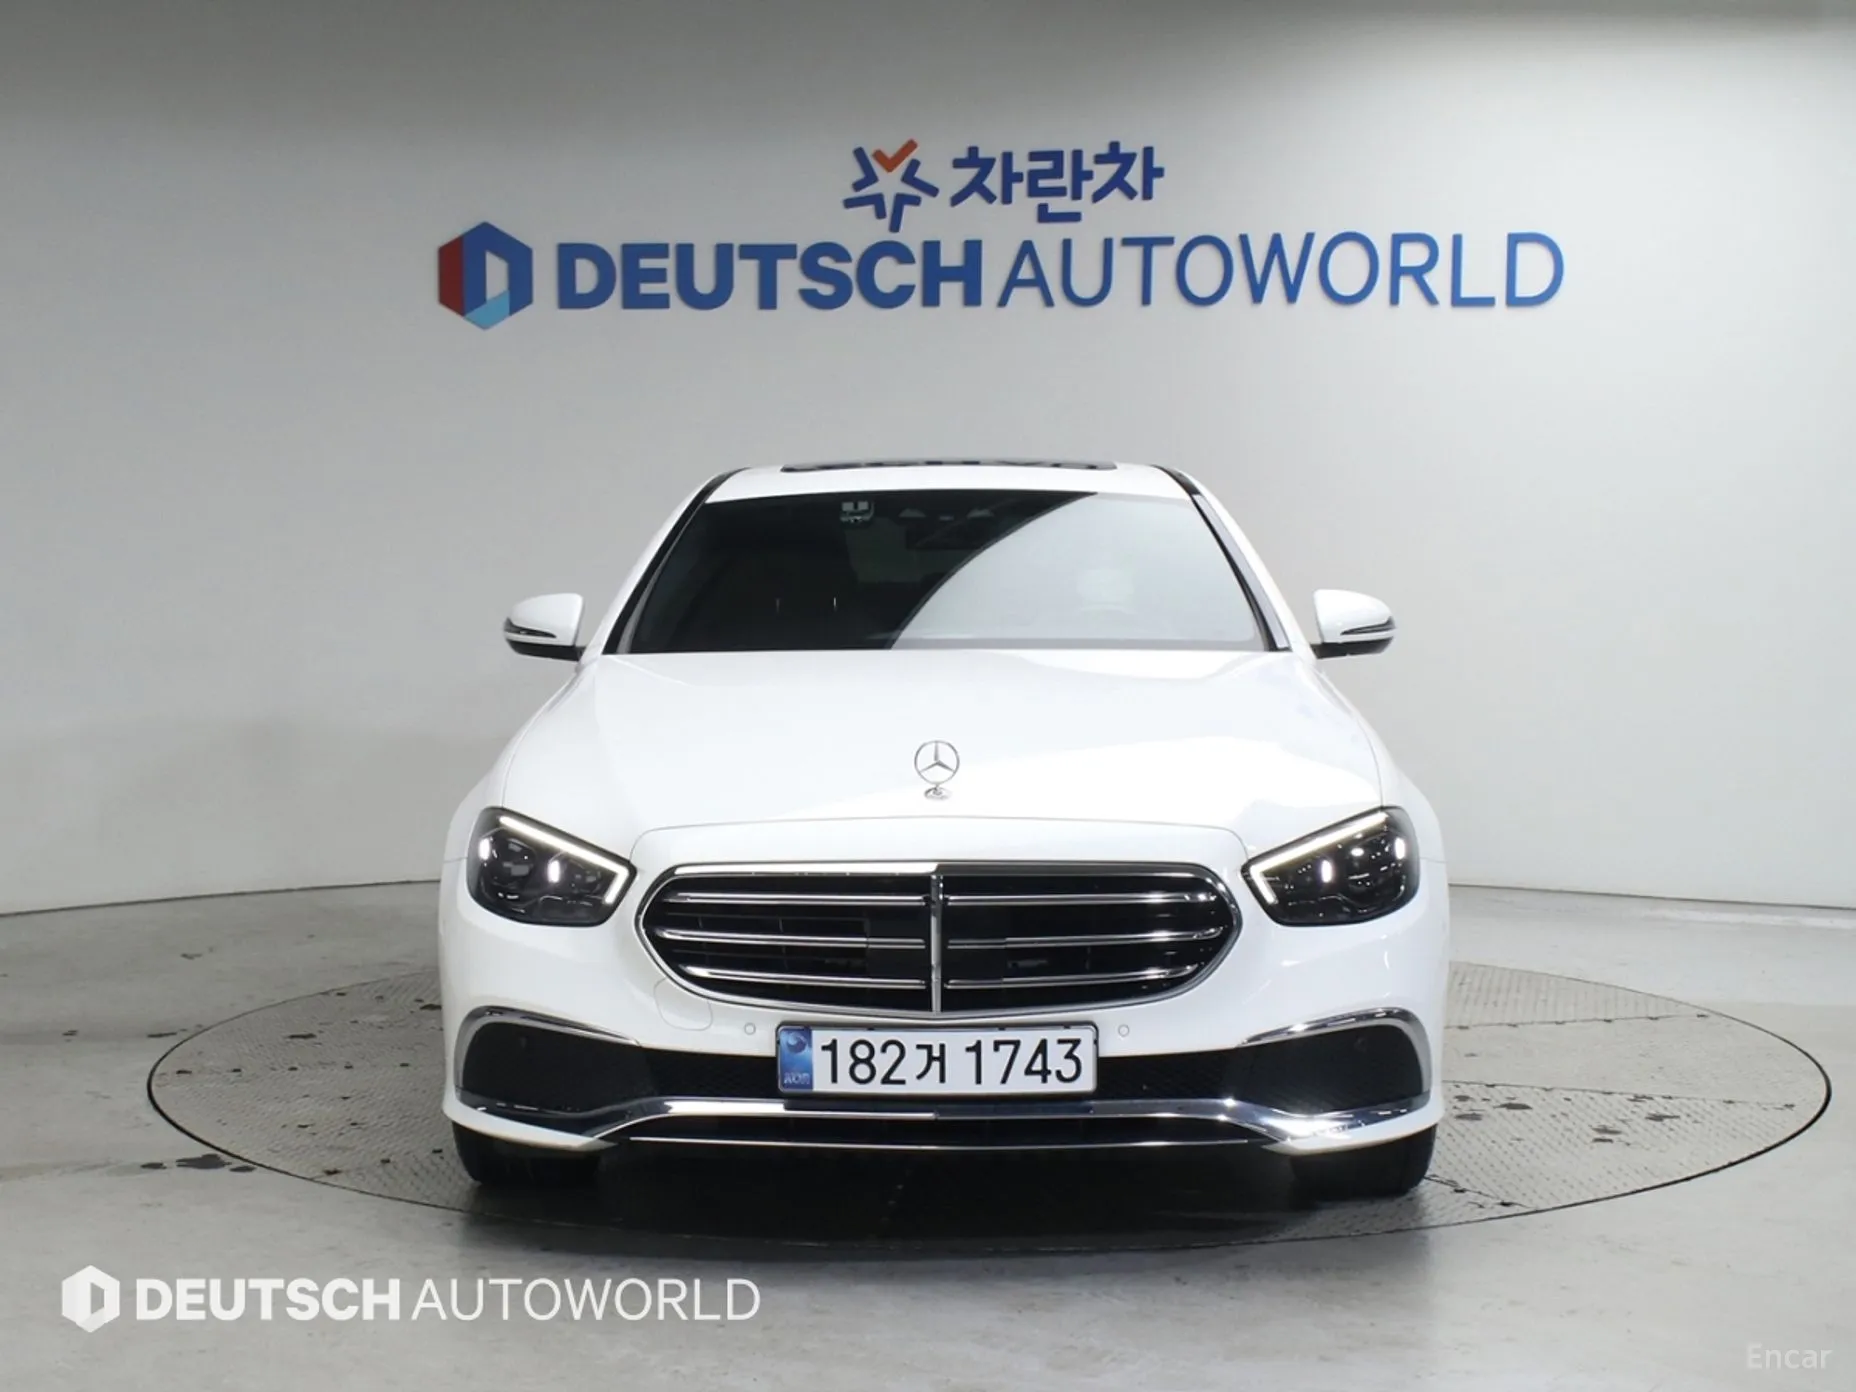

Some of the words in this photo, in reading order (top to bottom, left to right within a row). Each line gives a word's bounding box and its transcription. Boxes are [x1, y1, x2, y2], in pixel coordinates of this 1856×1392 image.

[951, 141, 1164, 223] 차란차
[556, 239, 983, 310] DEUTSCH
[998, 231, 1565, 307] AUTOWORLD
[820, 1038, 947, 1085] 182거
[965, 1038, 1083, 1085] 1743
